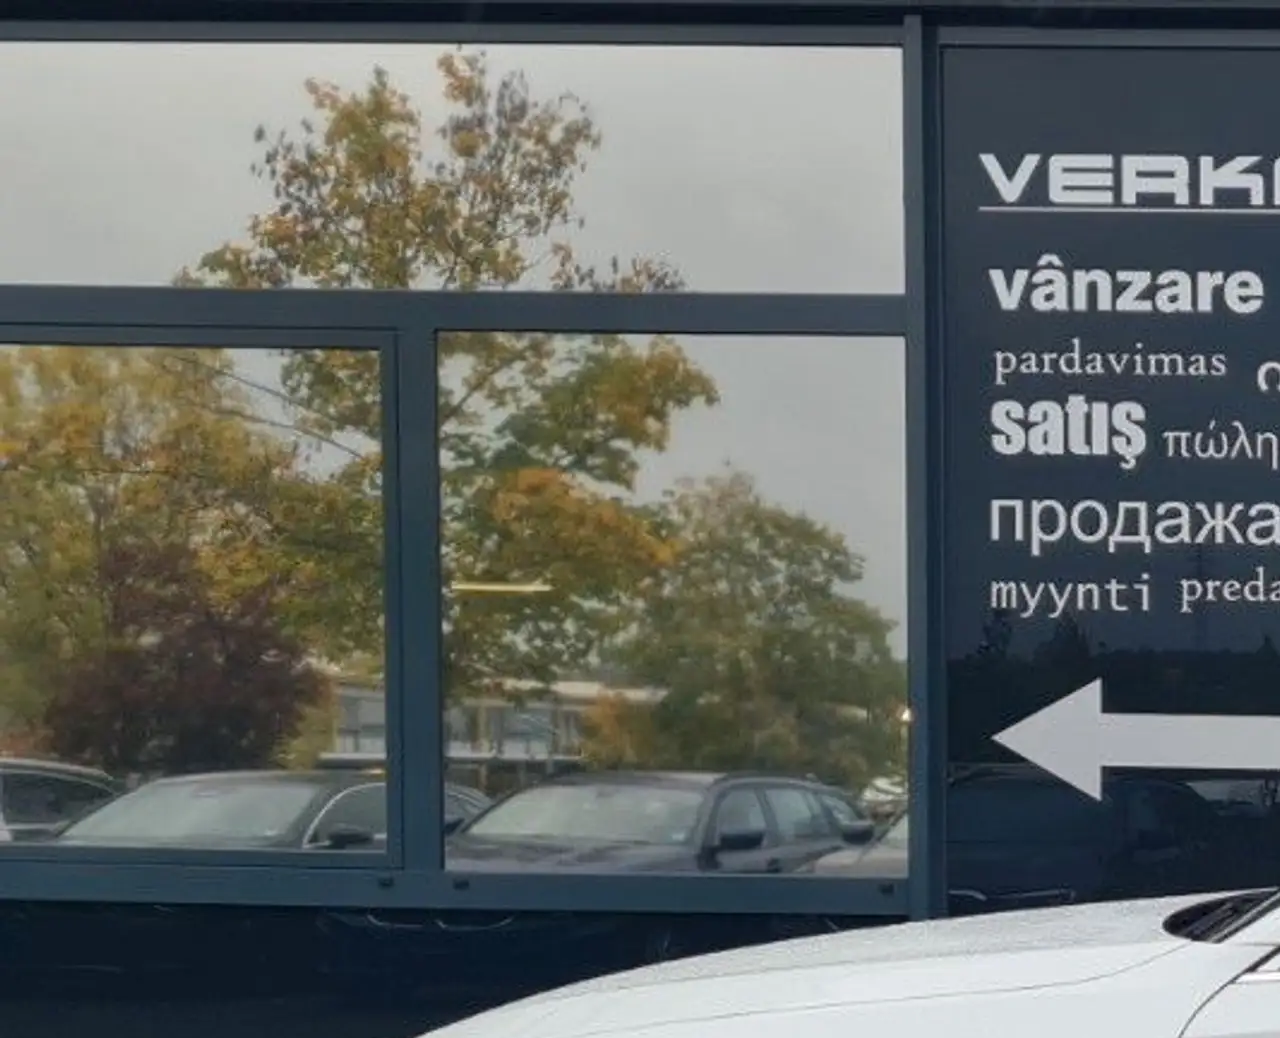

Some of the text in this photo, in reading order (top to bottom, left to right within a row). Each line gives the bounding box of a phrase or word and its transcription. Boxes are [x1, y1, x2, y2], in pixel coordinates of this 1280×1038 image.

[988, 253, 1265, 314] vânzare
[995, 337, 1227, 386] pardavimas
[990, 394, 1147, 470] satış
[990, 572, 1150, 619] myynti
